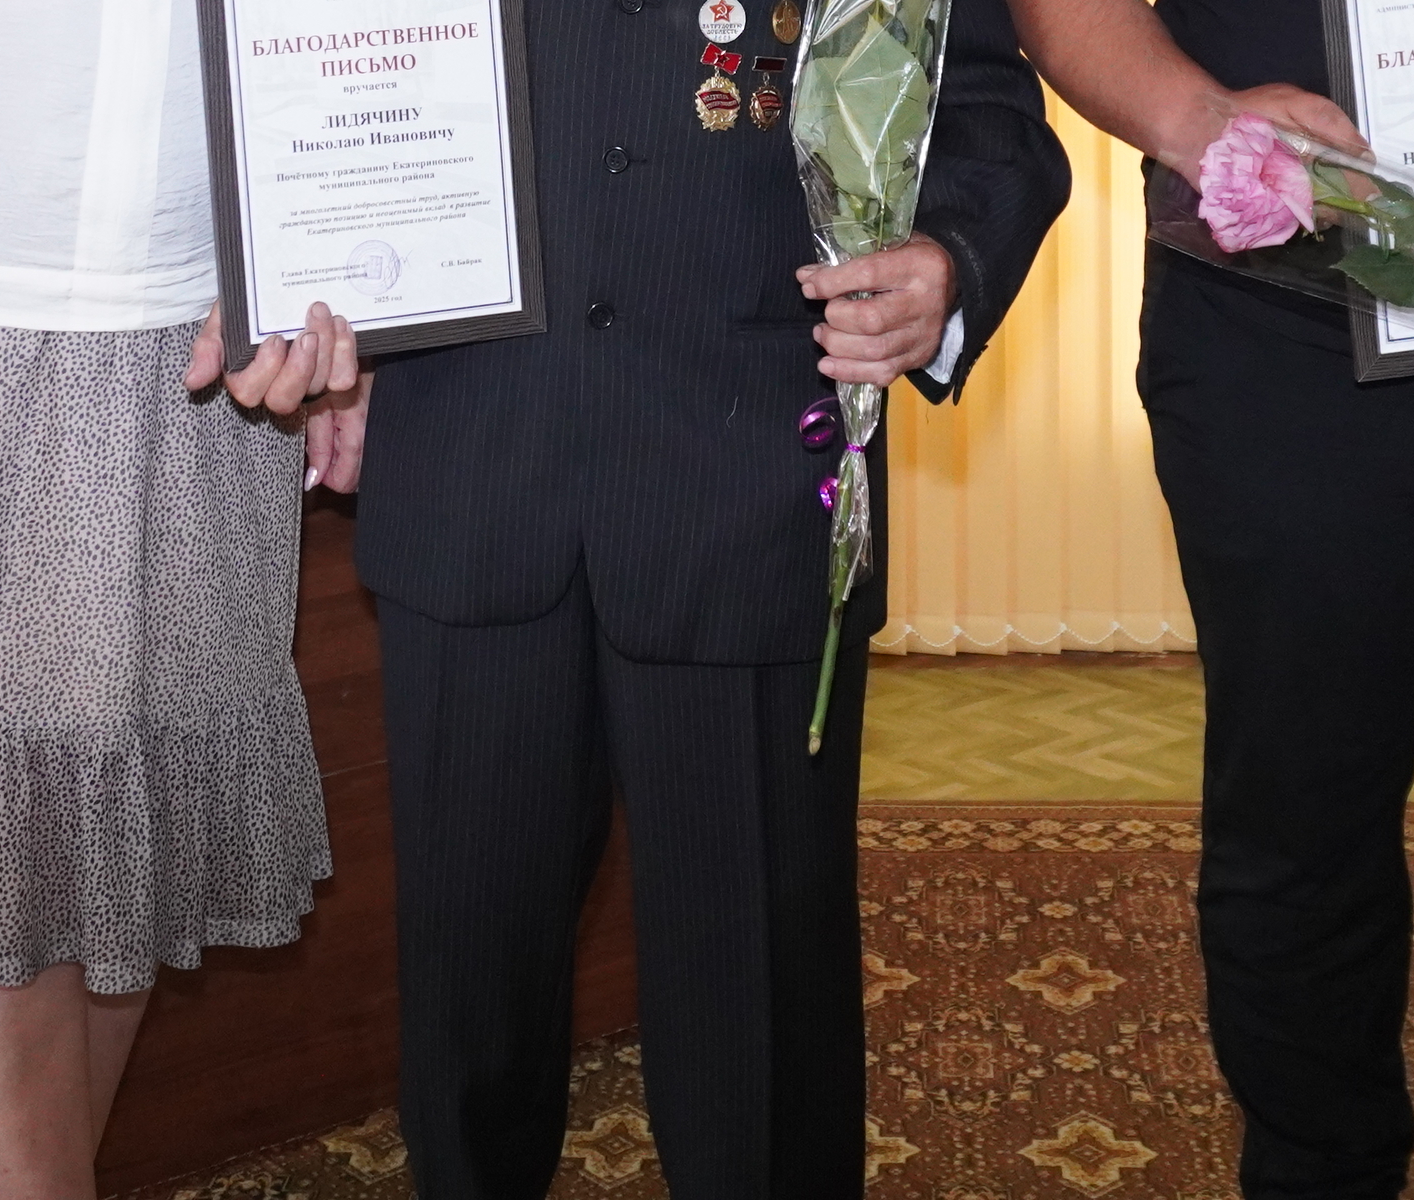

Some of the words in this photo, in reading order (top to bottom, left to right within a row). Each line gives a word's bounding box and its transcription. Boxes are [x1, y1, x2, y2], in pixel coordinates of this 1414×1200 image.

[252, 22, 479, 57] БЛАГОДАРСТВЕННОЕ
[320, 53, 416, 78] ПИСЬМО
[343, 81, 398, 95] вручается
[321, 106, 423, 130] ЛИДЯЧИНУ
[292, 137, 365, 153] Николаю
[370, 128, 455, 146] Ивановичу
[276, 170, 330, 182] Почётному
[332, 164, 390, 178] гражданину
[392, 156, 474, 170] Екатериновского
[319, 176, 400, 192] муниципального
[402, 172, 435, 184] района
[279, 216, 332, 230] гражданскую
[333, 212, 367, 222] позицию
[375, 206, 423, 217] неоценимый
[425, 204, 447, 212] вклад
[455, 199, 491, 210] развитие
[299, 203, 352, 215] многолетний
[353, 196, 417, 210] добросовестный
[418, 194, 440, 204] труд,
[441, 190, 480, 200] активную
[307, 223, 374, 236] Екатериновского
[375, 216, 438, 230] муниципального
[439, 212, 466, 222] района
[281, 270, 302, 278] Глава
[441, 260, 455, 268] С.В.
[457, 258, 482, 267] Байрак
[282, 275, 342, 288] муниципального
[374, 296, 390, 304] 2025
